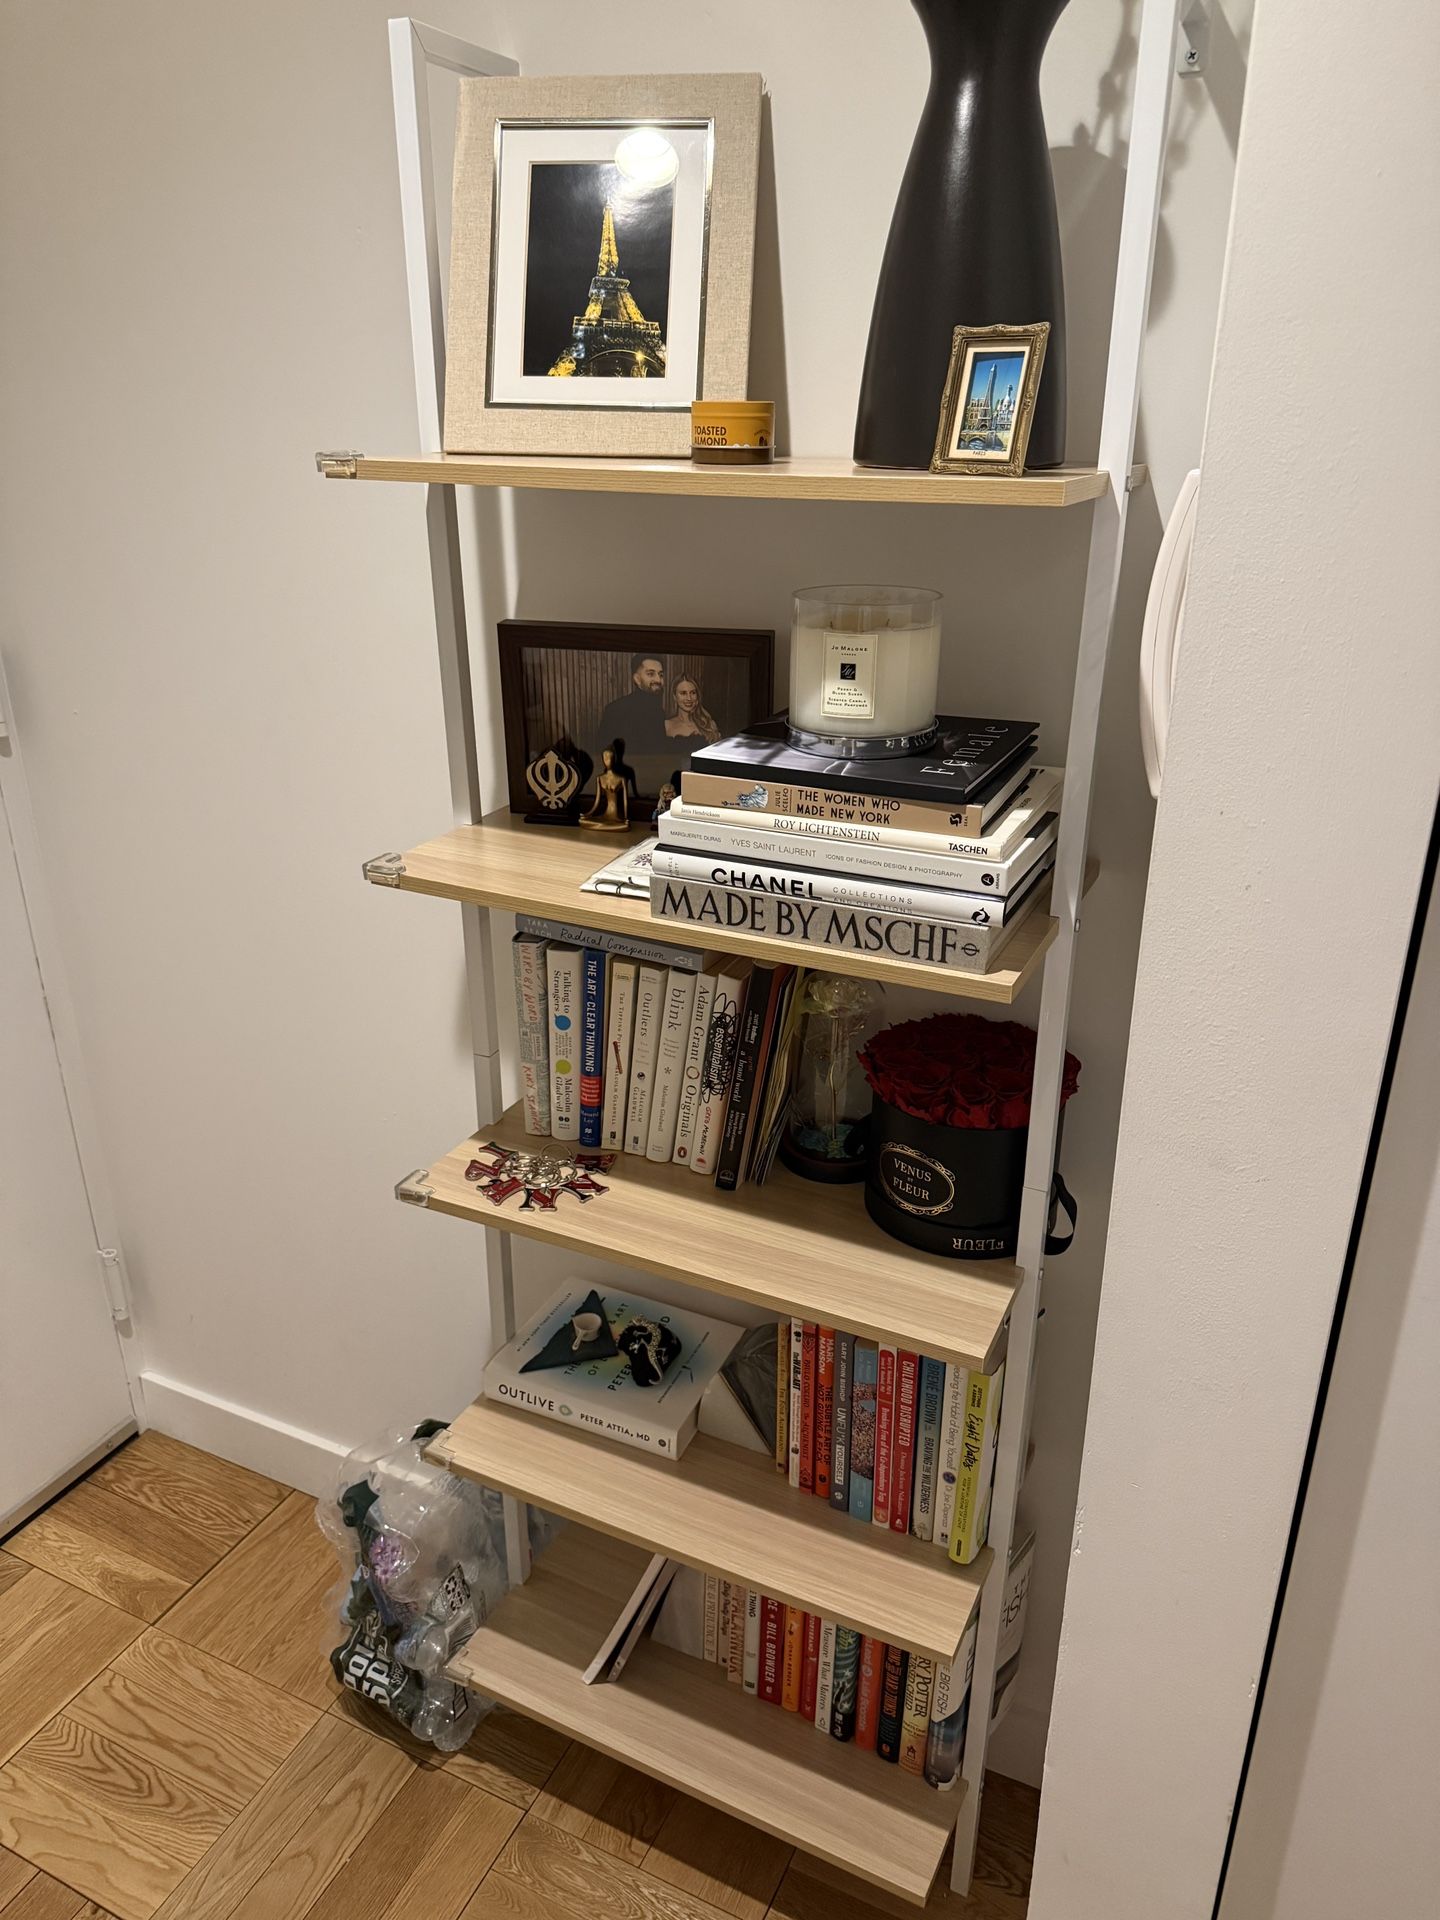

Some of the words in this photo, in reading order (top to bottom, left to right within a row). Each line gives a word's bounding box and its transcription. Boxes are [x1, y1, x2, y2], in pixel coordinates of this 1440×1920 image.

[694, 426, 726, 436] TOASTED
[798, 790, 819, 802] THE
[824, 792, 865, 807] WOMEN
[870, 798, 900, 812] WHO
[796, 804, 825, 817] MADE
[831, 809, 853, 820] NEW
[859, 811, 890, 824] YORK
[670, 830, 702, 840] MARGUERITE
[774, 818, 795, 830] ROY
[799, 822, 880, 841] LICHTENSTEIN
[730, 838, 750, 848] YVES
[753, 841, 776, 852] SAINT
[778, 846, 816, 857] LAURENT
[949, 842, 988, 855] TASCHEN
[826, 854, 844, 862] ICONS
[856, 858, 882, 867] FASHION
[884, 862, 907, 871] DESIGN
[914, 867, 963, 878] PHOTOGRAPHY
[711, 868, 822, 900] CHANEL
[833, 886, 912, 905] COLLECTIONS
[526, 918, 548, 929] TARA
[660, 883, 766, 931] MADE
[776, 900, 819, 939] BY
[824, 909, 958, 963] MSCHF
[560, 928, 602, 945] Radical
[606, 936, 667, 961] Compassion
[588, 961, 596, 977] THE
[552, 970, 560, 1012] Strangers
[562, 970, 571, 1003] Talking
[587, 980, 596, 995] ART
[524, 993, 537, 1023] WORD
[563, 1005, 570, 1013] to
[586, 1001, 596, 1030] CLEAR
[640, 992, 653, 1037] Outliers
[668, 988, 686, 1031] blink
[696, 985, 709, 1022] Adam
[586, 1031, 595, 1072] THINKING
[690, 1026, 704, 1061] Grant
[709, 1027, 724, 1084] essentialism
[737, 1060, 747, 1081] brand
[564, 1078, 573, 1113] Malcolm
[631, 1086, 639, 1122] GLADWELL
[733, 1083, 741, 1102] world
[680, 1085, 697, 1138] Originals
[894, 1158, 932, 1182] VENUS
[892, 1176, 930, 1200] FLEUR
[952, 1238, 1005, 1250] FLEUR
[616, 1303, 628, 1318] ART
[826, 1339, 834, 1363] MARK
[588, 1364, 600, 1376] OF
[792, 1360, 801, 1374] WAR
[926, 1363, 939, 1392] BRENÉ
[950, 1365, 963, 1390] reaking
[793, 1379, 801, 1391] ART
[825, 1385, 833, 1401] THE
[900, 1361, 914, 1404] CHILDHOOD
[952, 1390, 962, 1400] the
[498, 1384, 554, 1411] OUTLIVE
[924, 1393, 938, 1424] BROWN
[951, 1400, 960, 1419] Habit
[580, 1413, 604, 1426] PETER
[606, 1422, 634, 1437] ATTIA,
[636, 1432, 650, 1442] MD
[824, 1402, 832, 1433] SUBTLE
[899, 1405, 912, 1446] DISRUPTED
[966, 1413, 983, 1441] Eight
[946, 1428, 958, 1446] Being
[824, 1454, 831, 1465] OF
[923, 1437, 934, 1466] BRAVING
[963, 1442, 980, 1471] Dates
[835, 1446, 844, 1484] YOURSELF
[878, 1491, 886, 1502] Trap
[920, 1474, 931, 1514] WILDERNESS
[708, 1576, 716, 1592] IDE
[748, 1595, 756, 1618] THING
[705, 1600, 716, 1647] PREJUDICE
[766, 1622, 777, 1640] BILL
[821, 1626, 832, 1658] Measure
[765, 1642, 777, 1683] BROWDER
[821, 1660, 831, 1681] What
[939, 1672, 951, 1691] BIG
[819, 1683, 829, 1710] Matters
[905, 1685, 914, 1711] CHILD
[913, 1673, 932, 1718] POTTER
[937, 1690, 949, 1716] FISH
